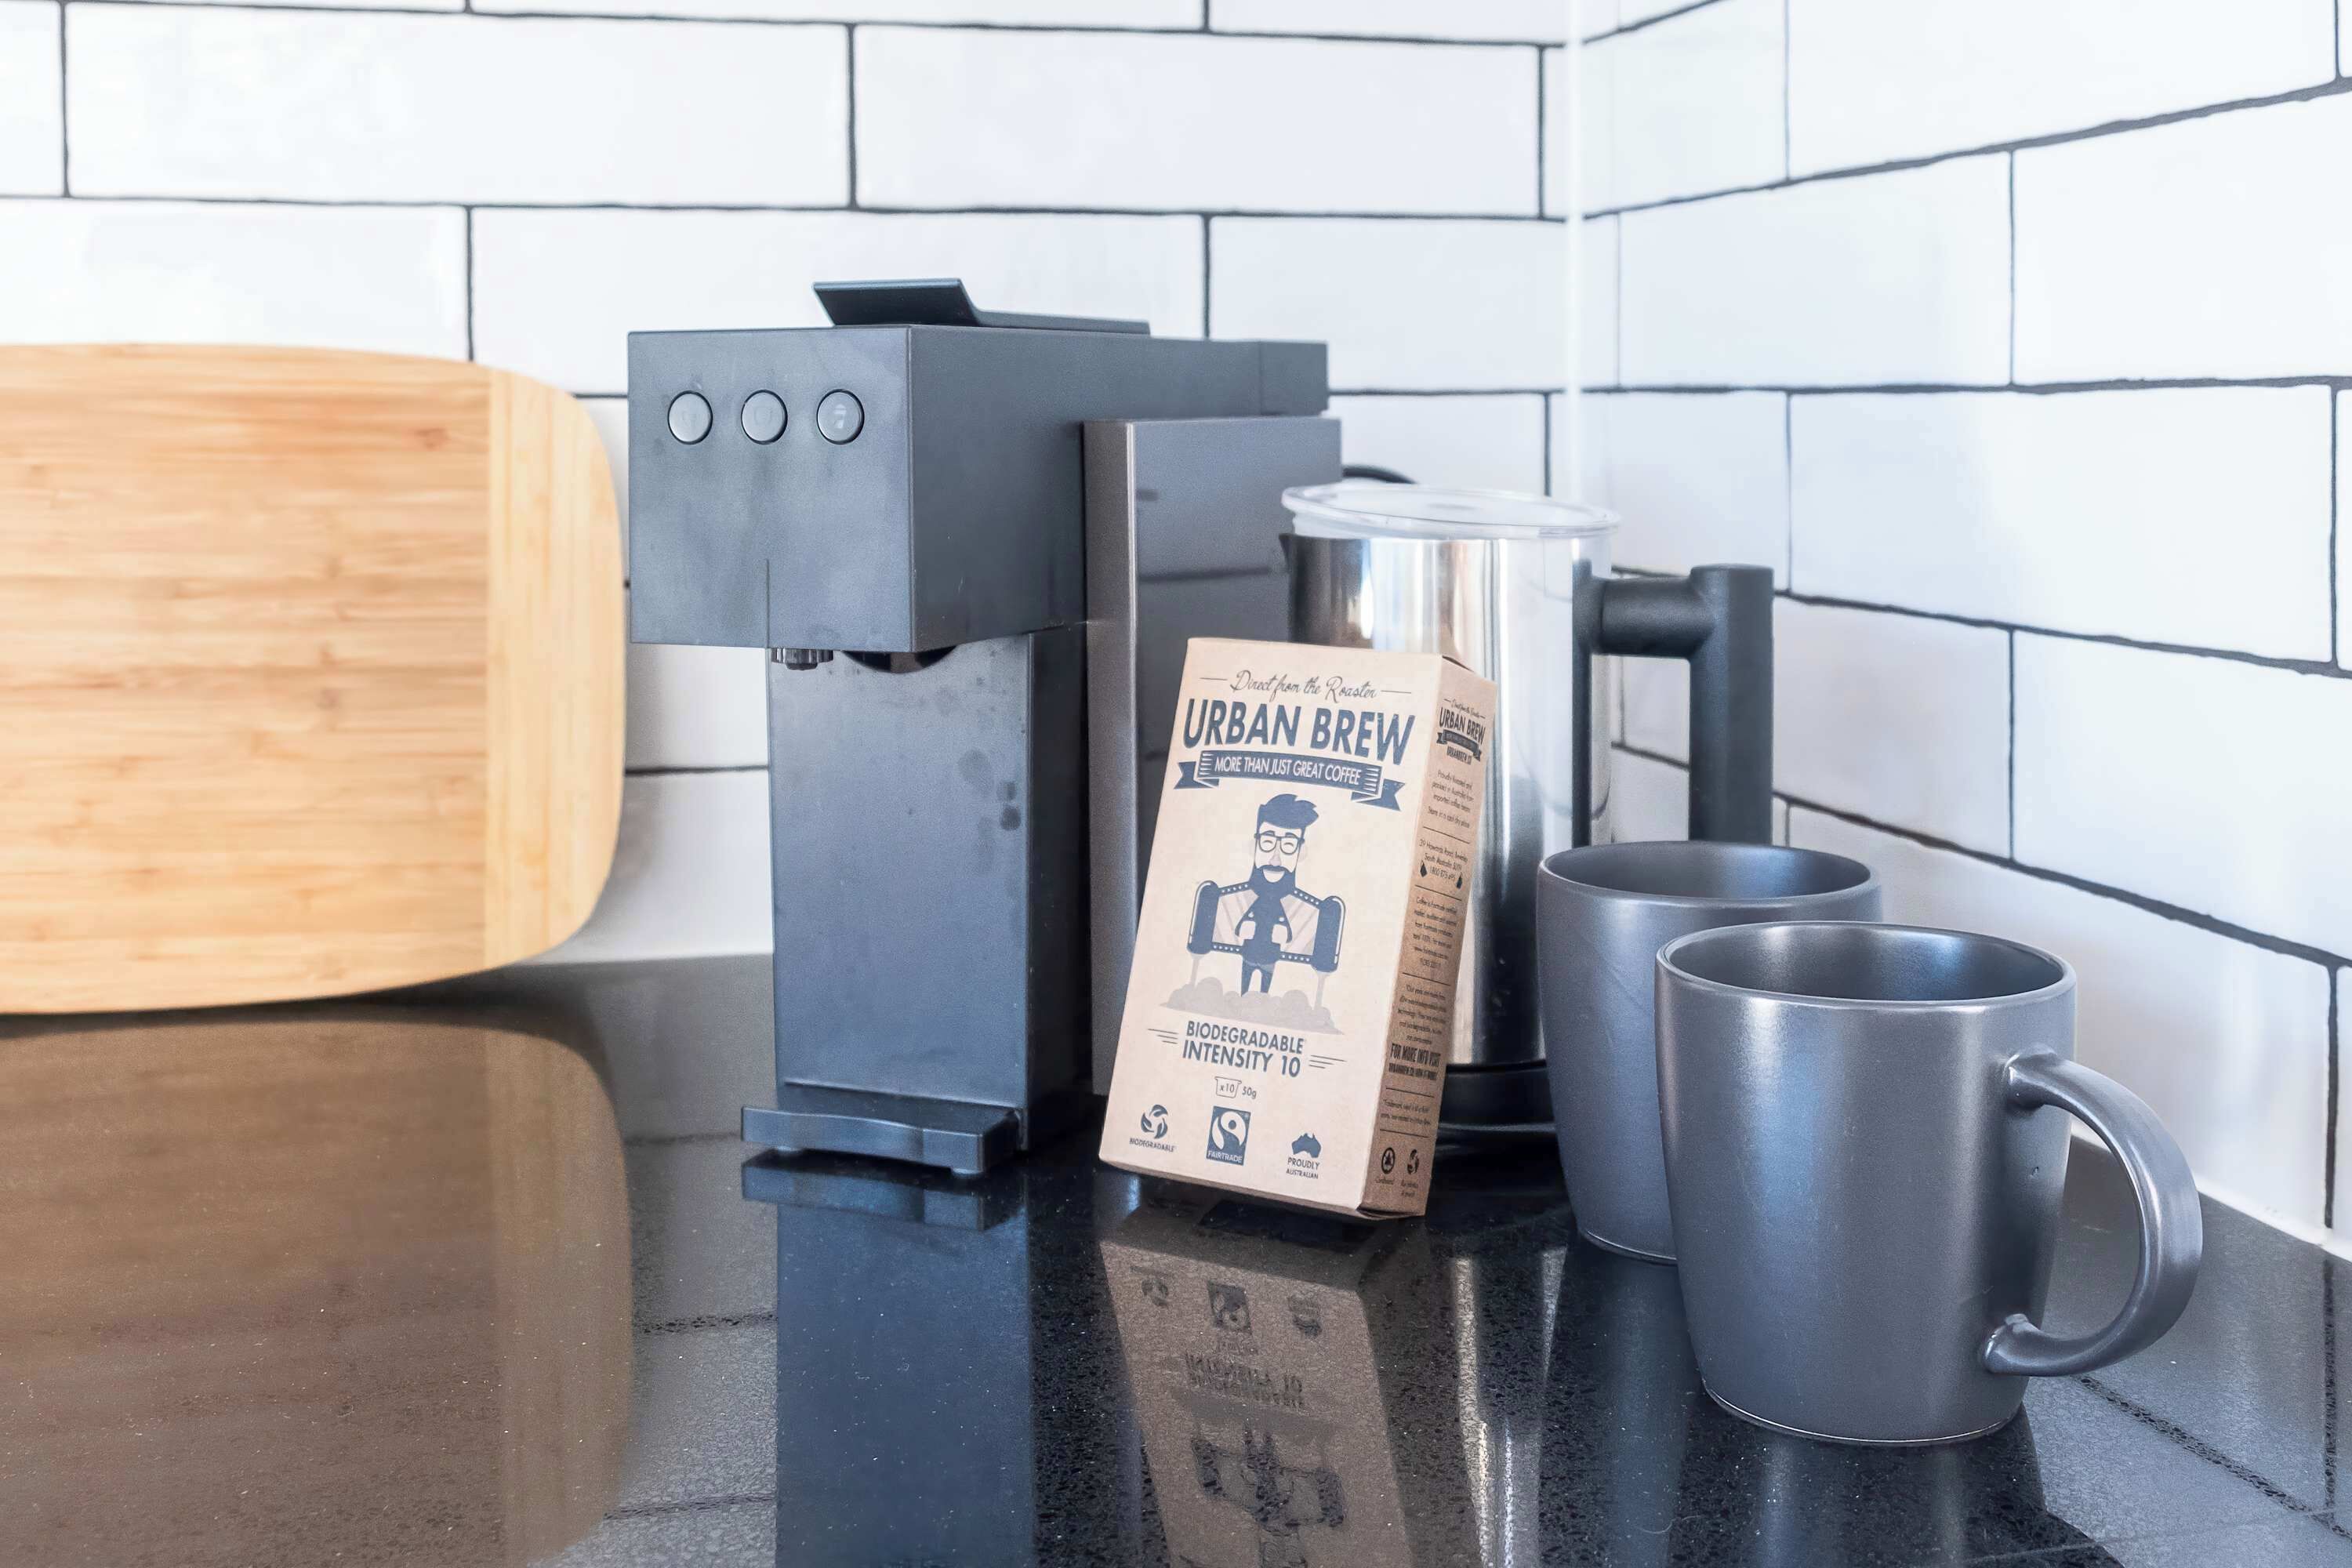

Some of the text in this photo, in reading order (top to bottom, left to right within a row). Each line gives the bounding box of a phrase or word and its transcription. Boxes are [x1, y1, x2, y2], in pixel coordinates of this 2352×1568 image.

[1230, 670, 1377, 703] Direct from the Roaster
[1183, 698, 1301, 749] URBAN
[1310, 707, 1416, 765] BREW
[1439, 706, 1465, 733] URBAN
[1467, 719, 1486, 745] BREW
[1214, 756, 1362, 785] MORE THAN JUST GREAT COFFEE
[1186, 1020, 1305, 1054] BIODEGRADABLE
[1182, 1040, 1301, 1078] INTENSITY 10
[1390, 1044, 1402, 1060] FOR
[1402, 1046, 1417, 1062] MORE
[1219, 1083, 1258, 1099] x10 50g
[1129, 1138, 1174, 1152] BIODEGRADABLE
[1207, 1150, 1243, 1163] FAIRTRADE
[1286, 1167, 1319, 1180] AUSTRALIAN
[1287, 1156, 1320, 1171] PROUDLY
